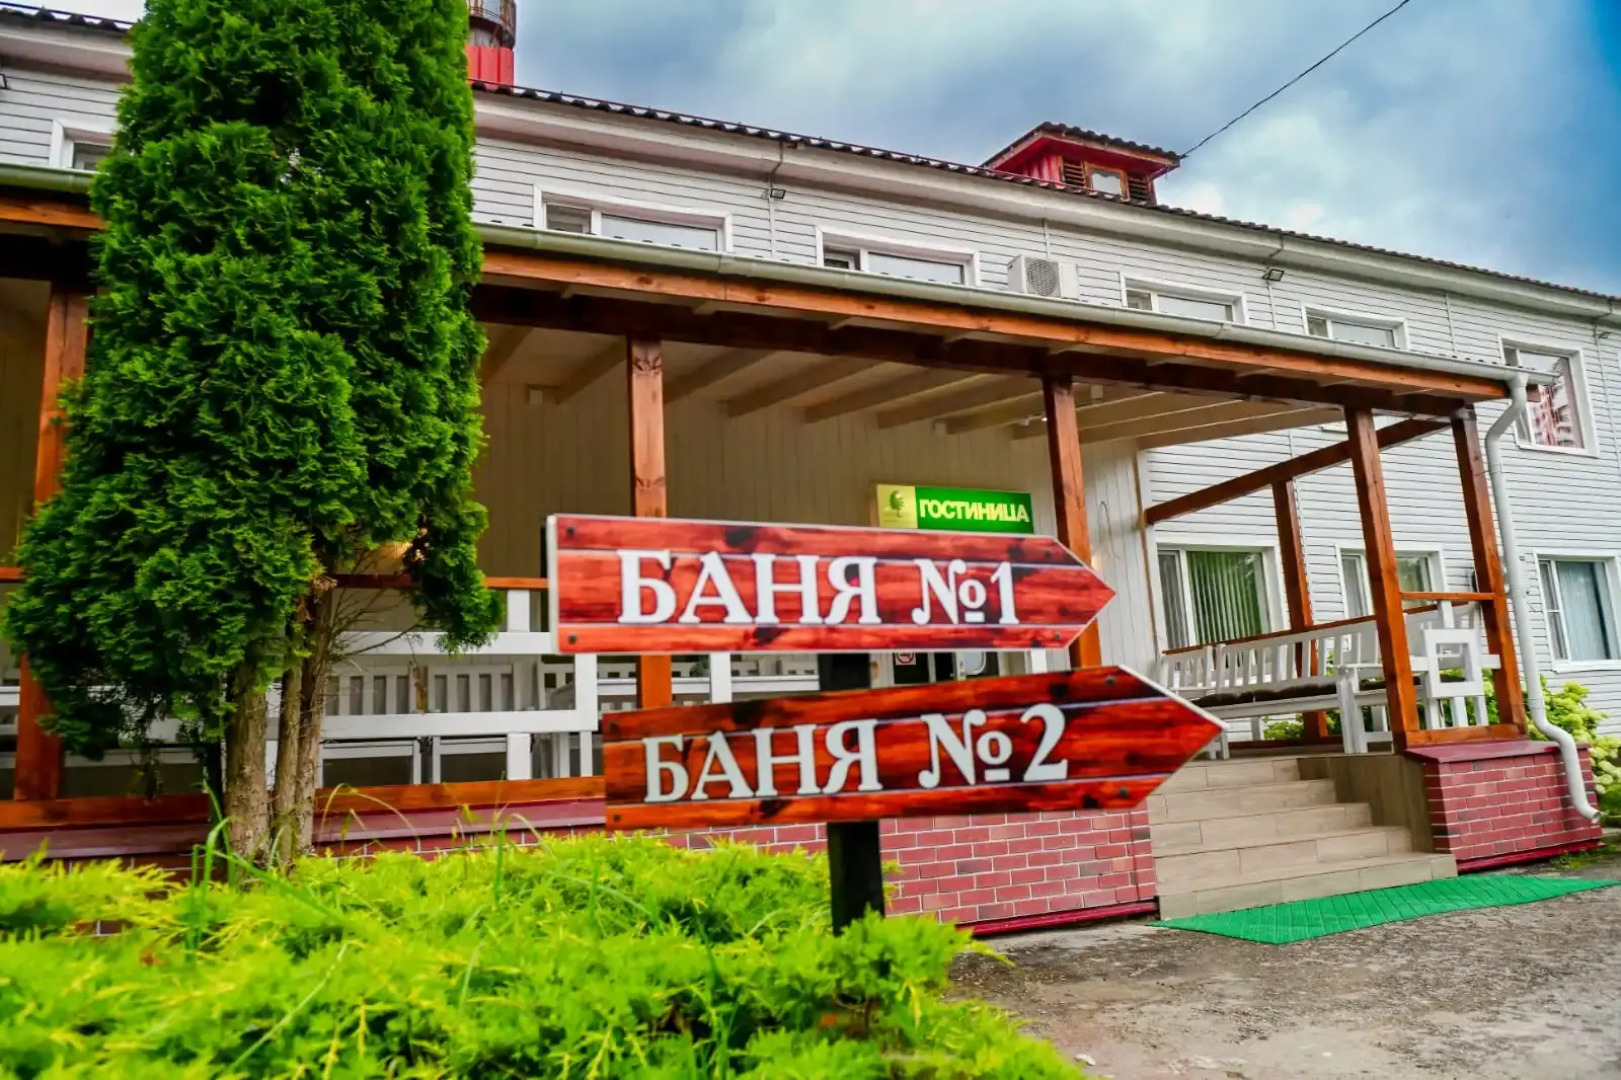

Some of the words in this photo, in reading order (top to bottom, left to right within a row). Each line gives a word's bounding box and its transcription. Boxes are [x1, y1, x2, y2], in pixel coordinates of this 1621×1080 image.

[919, 498, 1030, 522] ГОСТИНИЦА
[617, 549, 882, 626] БАНЯ
[911, 558, 1020, 626] №1
[642, 718, 885, 803] БАНЯ
[919, 703, 1069, 789] №2
